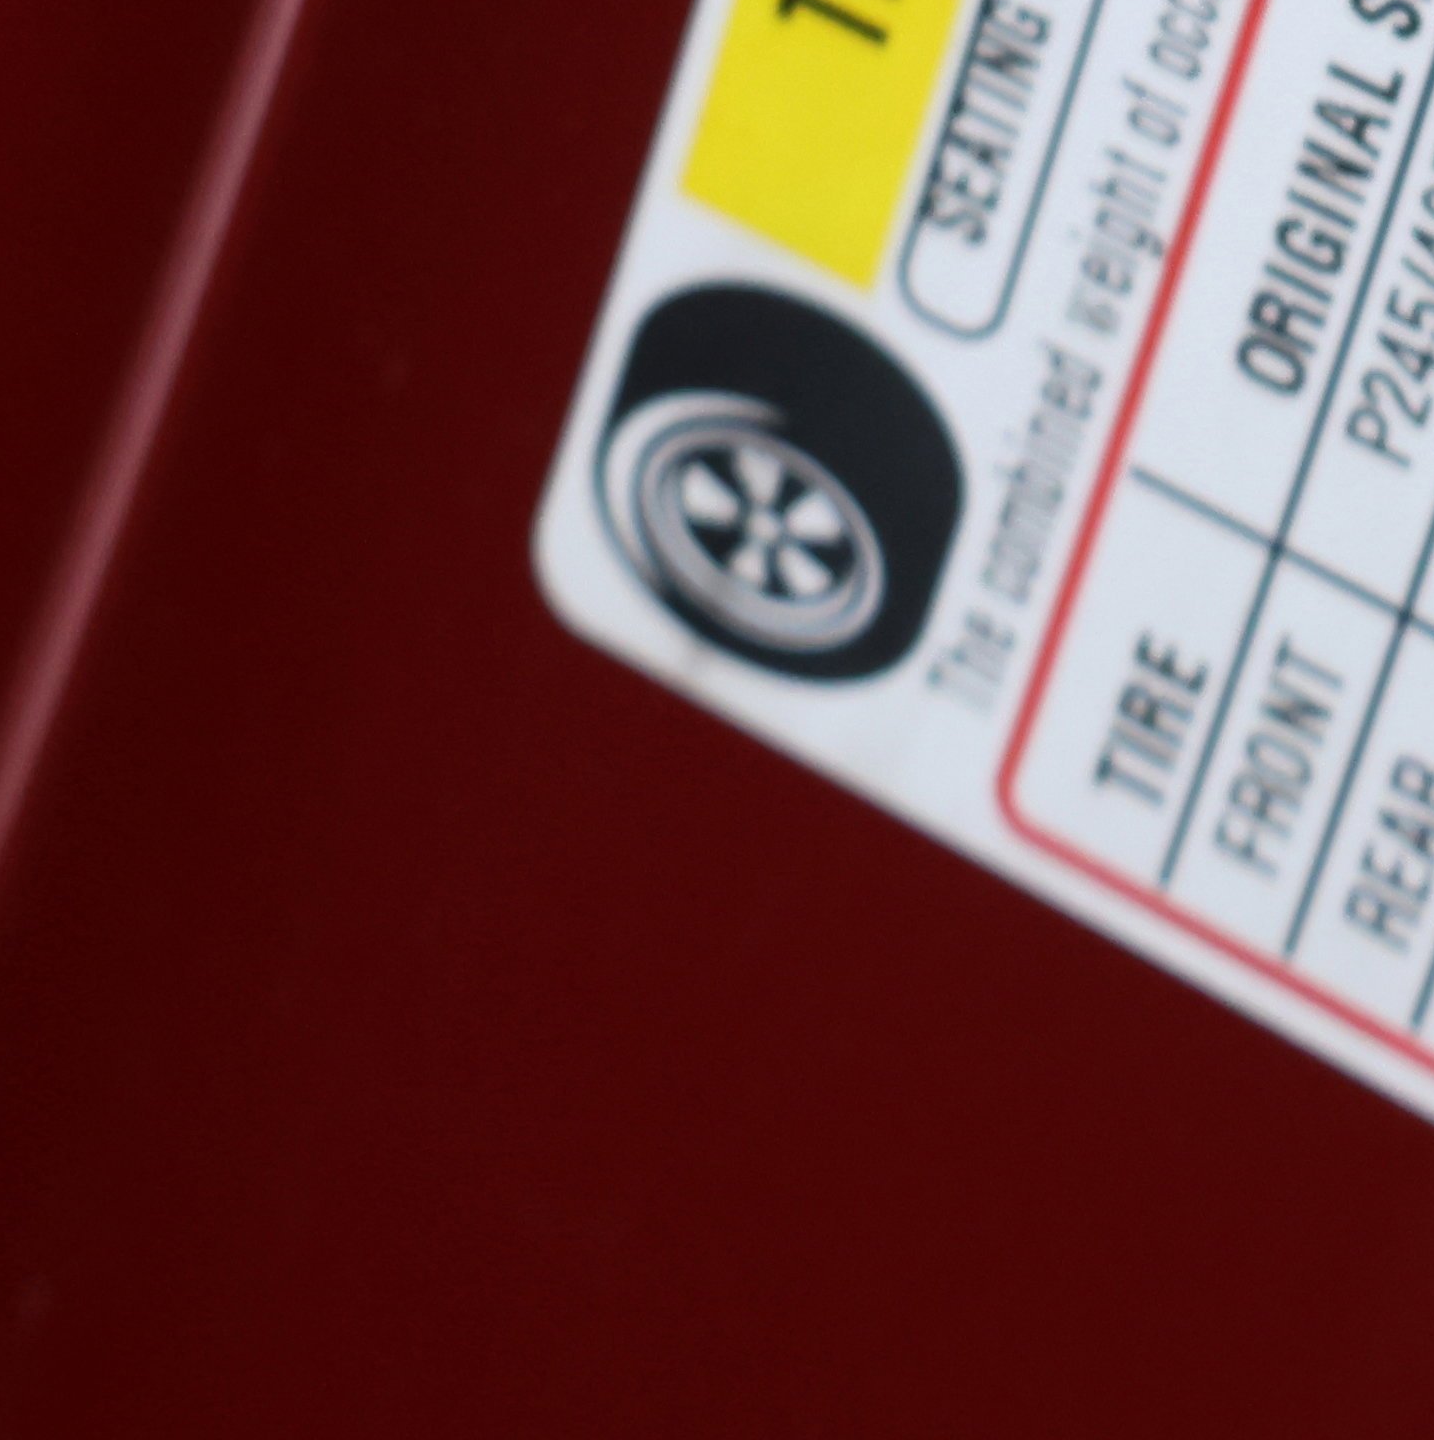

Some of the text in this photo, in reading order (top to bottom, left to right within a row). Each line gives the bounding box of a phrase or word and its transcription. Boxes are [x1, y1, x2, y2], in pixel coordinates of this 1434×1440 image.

[1121, 74, 1189, 149] of
[1233, 62, 1404, 398] ORIGINAL
[1090, 628, 1211, 811] TIRE
[1212, 635, 1346, 881] FRONT
